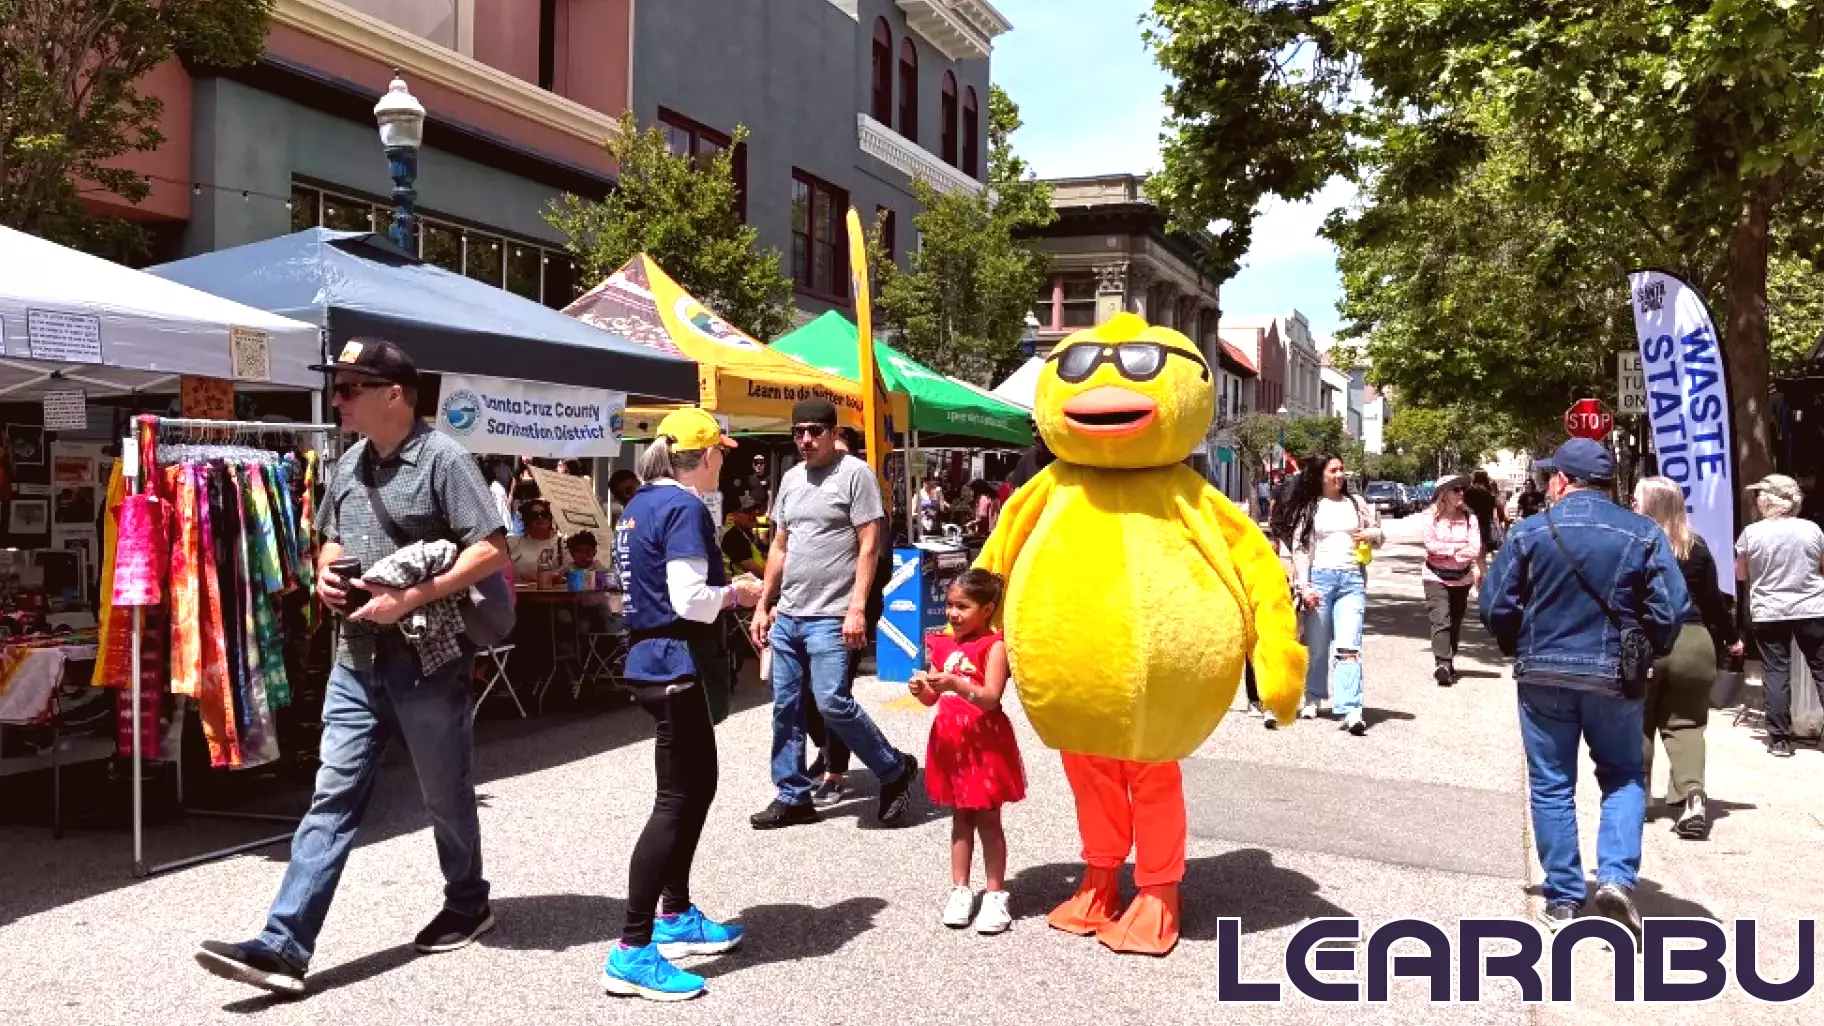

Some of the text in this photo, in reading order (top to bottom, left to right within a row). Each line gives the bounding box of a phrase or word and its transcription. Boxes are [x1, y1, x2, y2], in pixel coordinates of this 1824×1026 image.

[747, 380, 782, 400] Learn
[784, 386, 795, 400] to
[1623, 376, 1646, 390] TU
[524, 400, 552, 417] Cruz
[555, 402, 600, 421] County
[1680, 323, 1727, 481] WASTE
[1569, 413, 1610, 429] STOP
[554, 424, 604, 440] District
